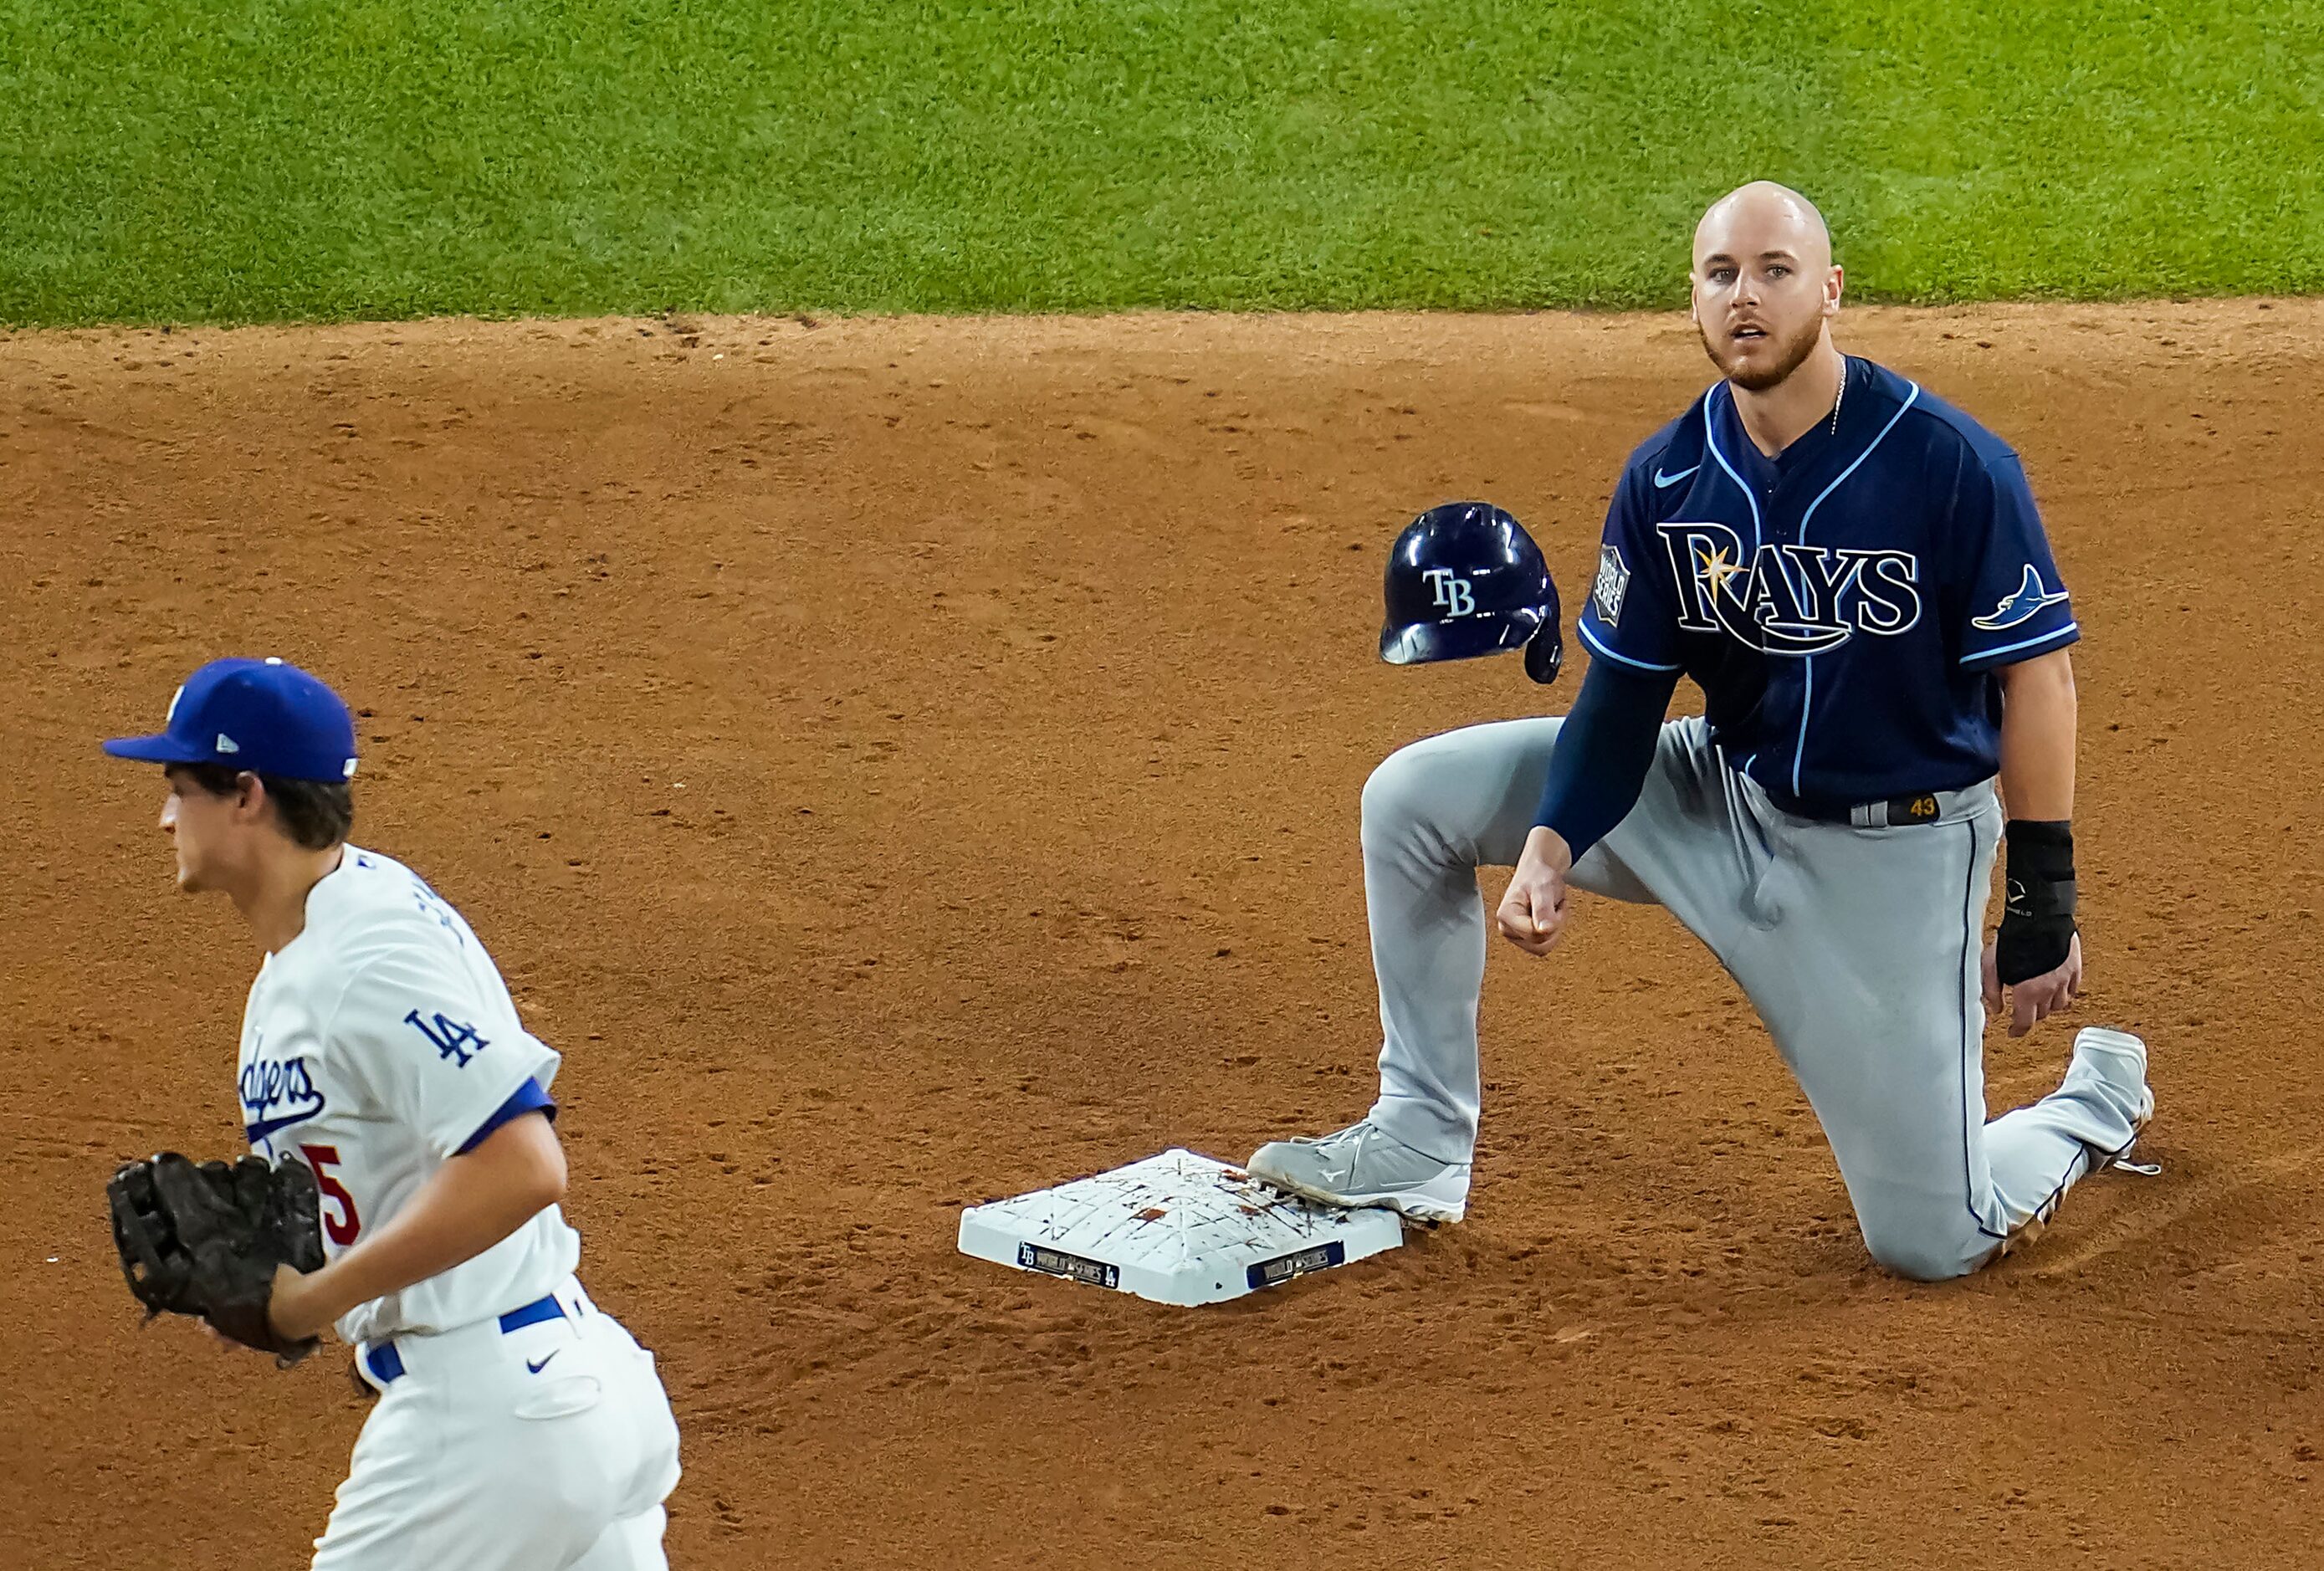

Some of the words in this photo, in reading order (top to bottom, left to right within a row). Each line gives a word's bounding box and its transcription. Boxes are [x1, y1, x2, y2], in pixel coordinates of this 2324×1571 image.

[1422, 567, 1476, 618] TB
[1595, 573, 1621, 617] SERIES
[1599, 553, 1625, 596] WORLD
[1656, 522, 1924, 655] RAYS
[1910, 797, 1936, 816] 43
[403, 1008, 491, 1068] LA
[238, 1034, 324, 1125] dgers
[299, 1143, 362, 1246] 5
[1020, 1242, 1035, 1266] TB
